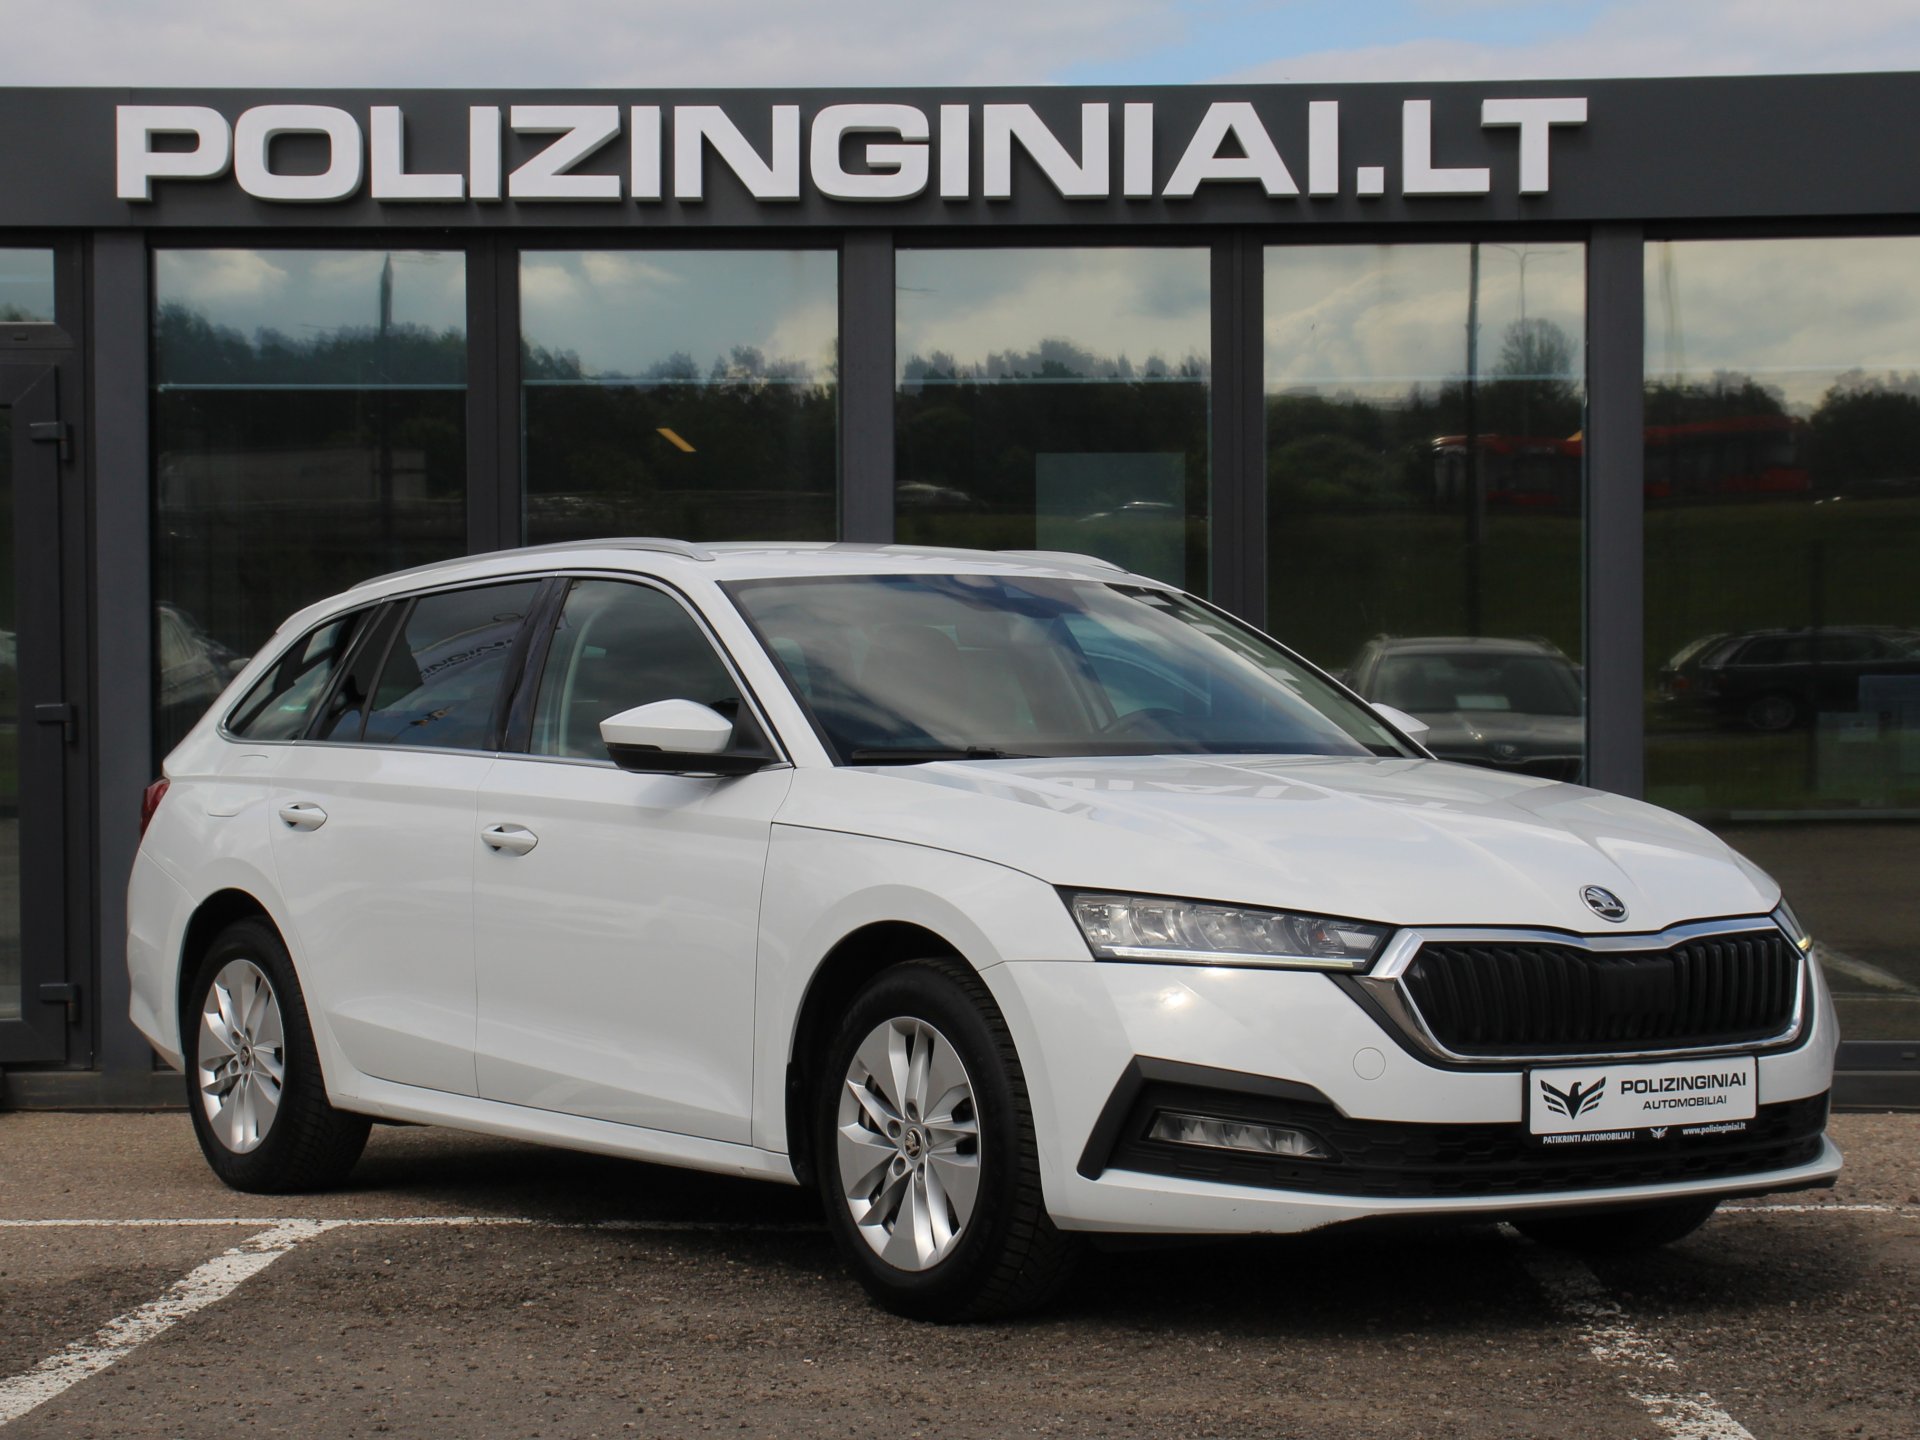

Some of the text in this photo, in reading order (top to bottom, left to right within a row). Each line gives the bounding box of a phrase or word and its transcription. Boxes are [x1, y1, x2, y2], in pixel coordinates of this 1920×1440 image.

[116, 97, 1588, 202] POLIZINGINIAI.LT
[1621, 1072, 1746, 1095] POLIZINGINIAI
[1643, 1095, 1727, 1111] AUTOMOBILIAI
[1682, 1121, 1747, 1136] www.polizinginiai.lt
[1543, 1134, 1580, 1145] PATIKRINTI
[1582, 1131, 1631, 1143] AUTOMOBILIAI
